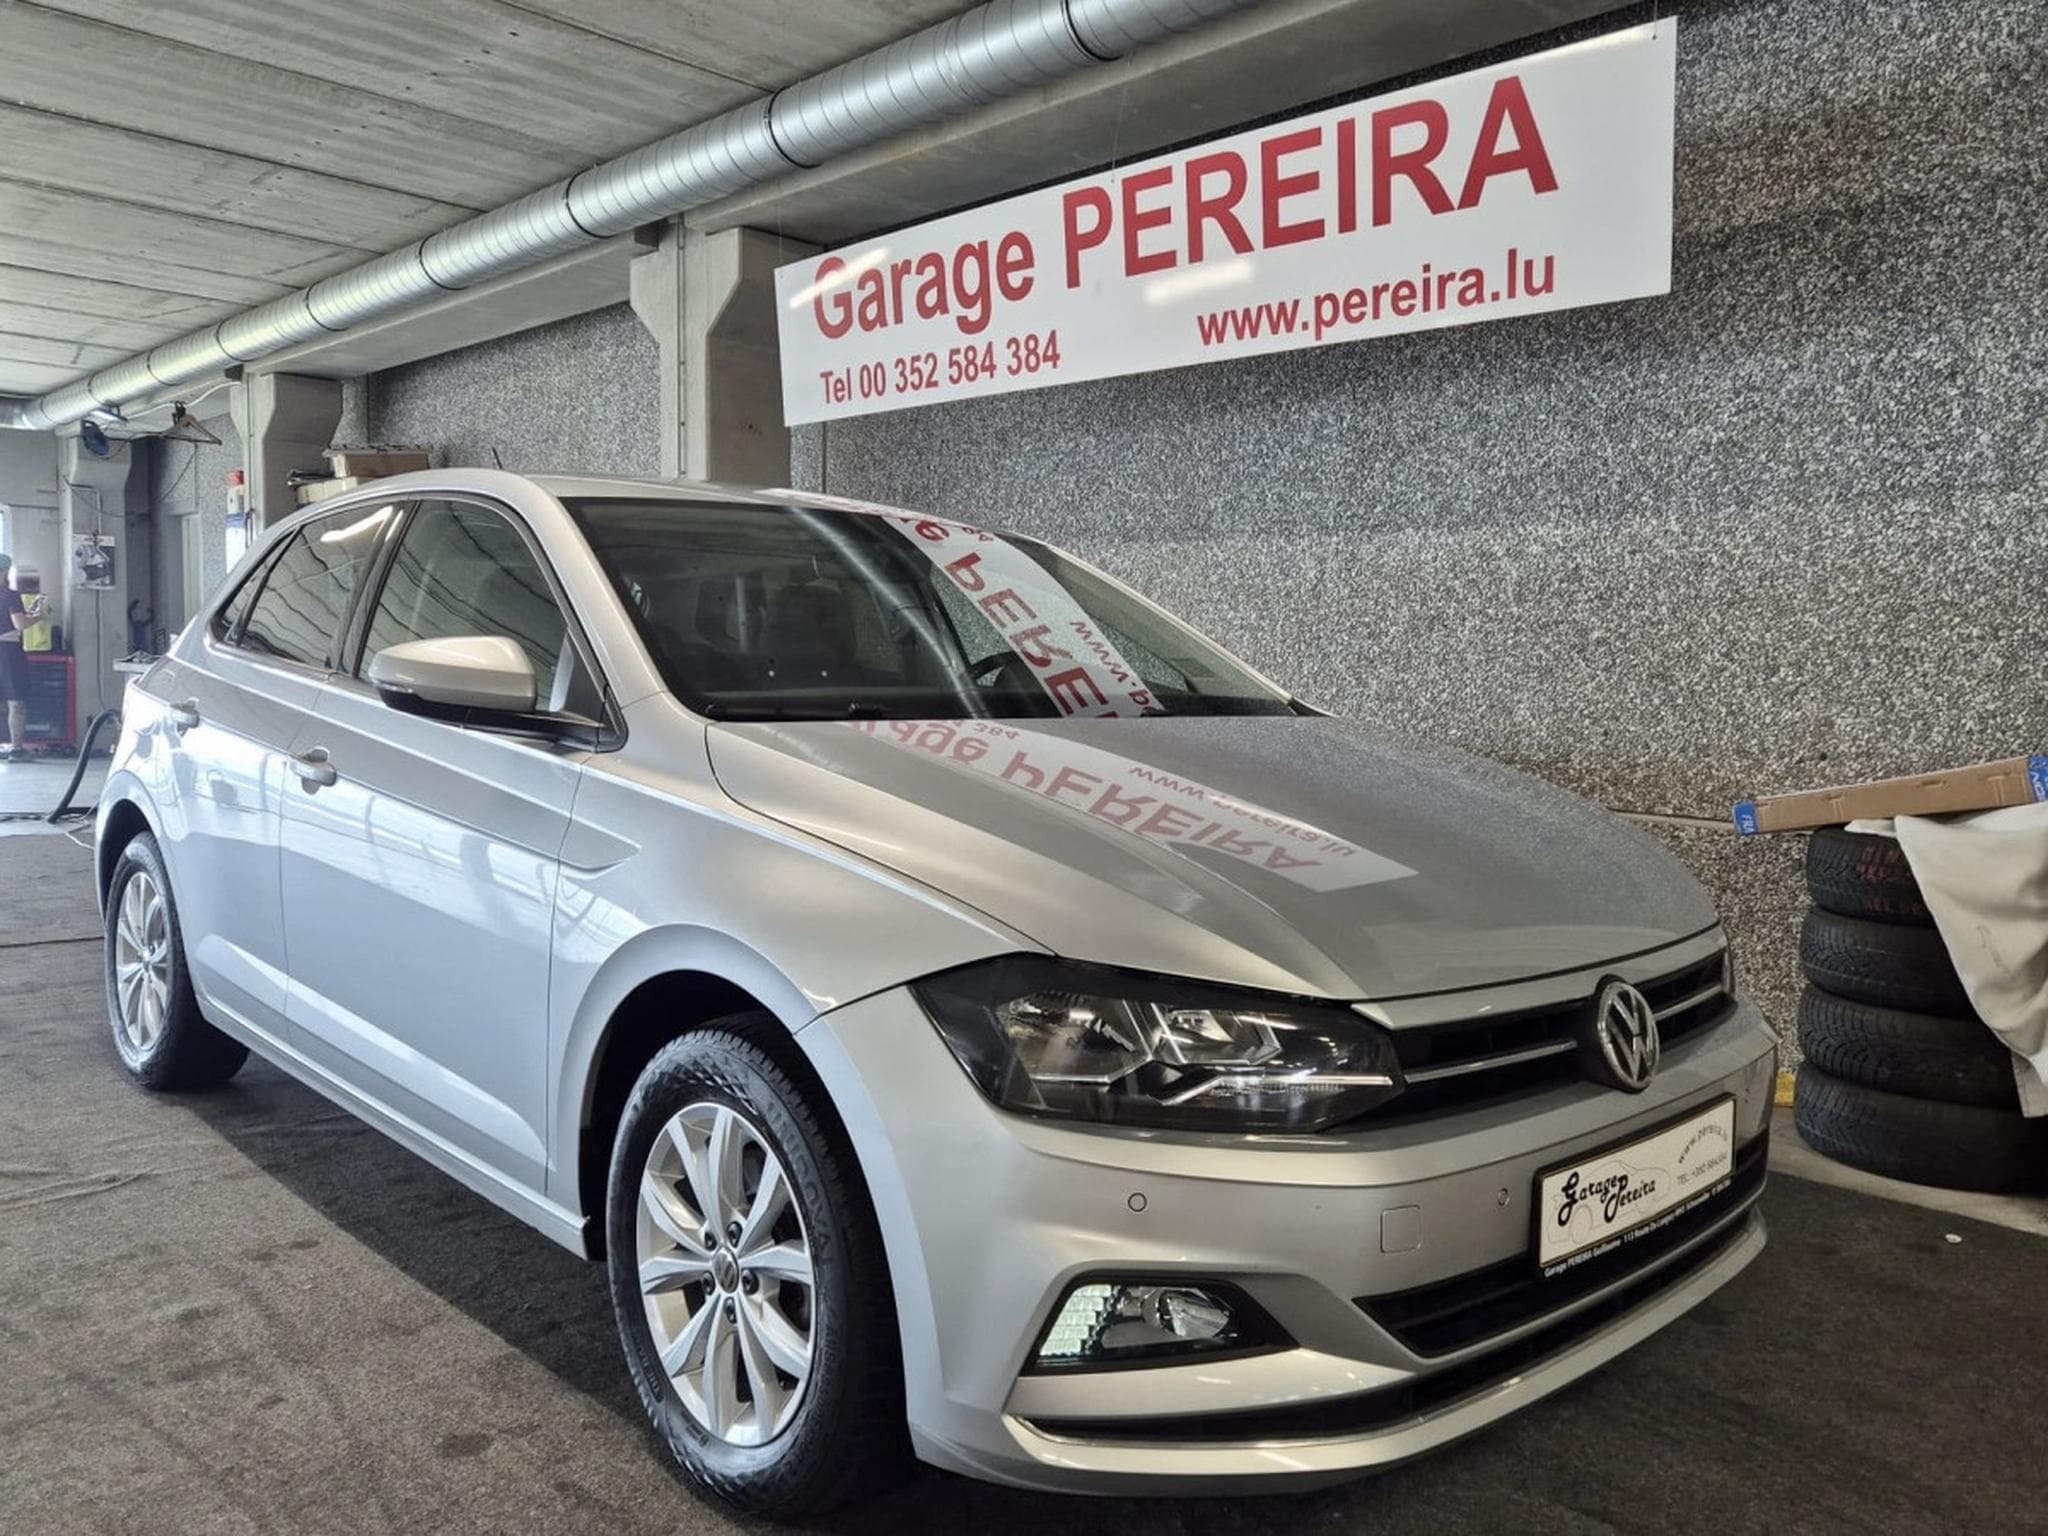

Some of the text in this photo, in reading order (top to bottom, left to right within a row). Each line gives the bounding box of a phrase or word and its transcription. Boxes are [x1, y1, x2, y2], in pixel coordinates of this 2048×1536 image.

[813, 76, 1558, 340] Garage PEREIRA
[1197, 249, 1556, 346] www.pereira.lu
[819, 330, 1061, 405] Tel 00 352 584 384
